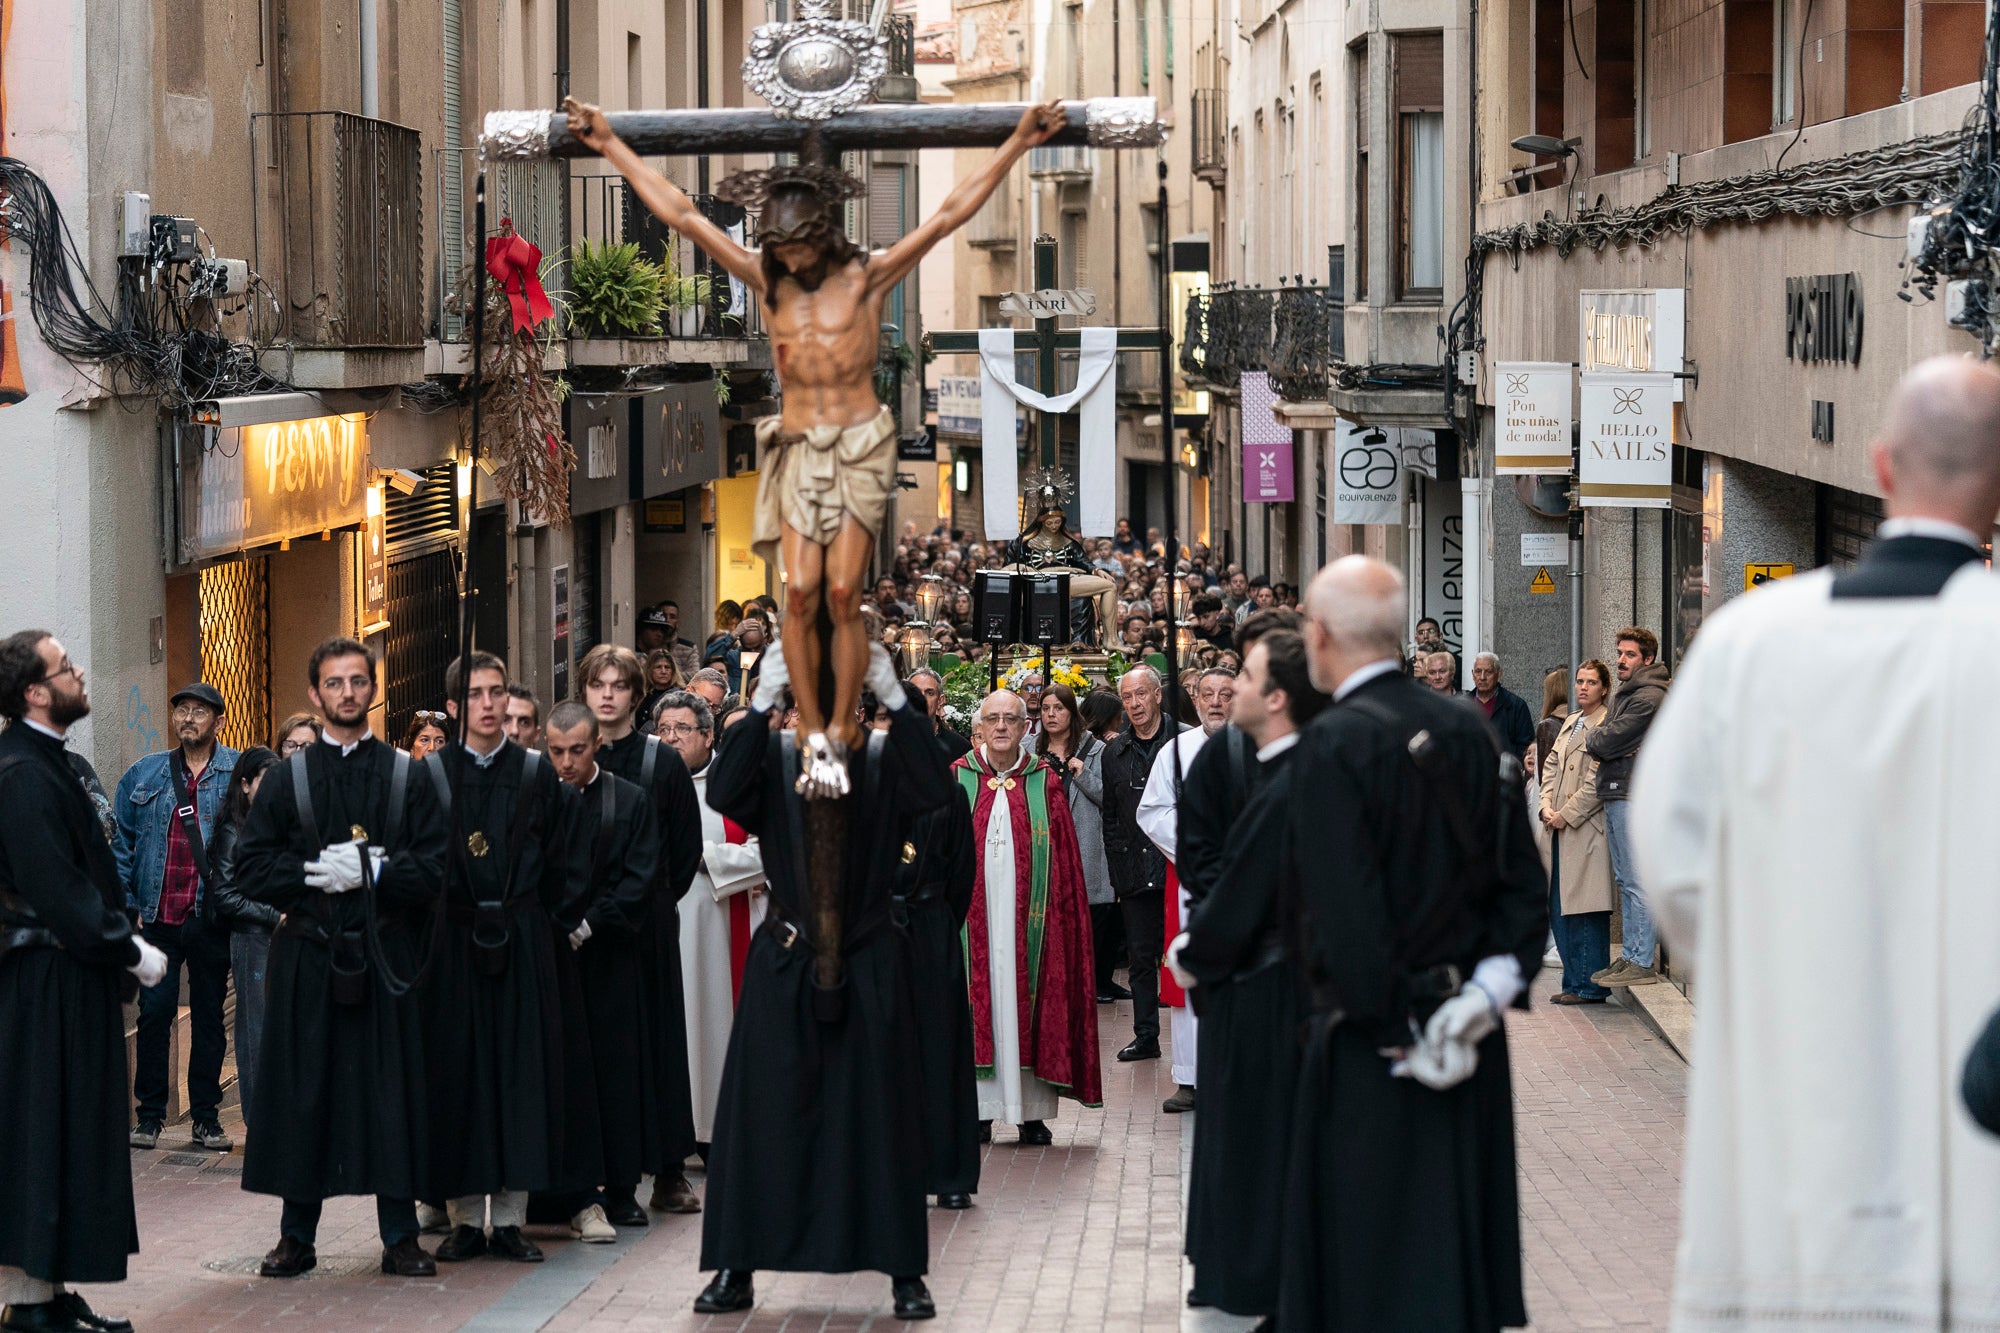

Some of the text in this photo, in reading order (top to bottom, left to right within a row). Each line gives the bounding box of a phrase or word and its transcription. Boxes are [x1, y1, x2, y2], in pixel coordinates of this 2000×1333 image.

[1786, 271, 1864, 364] POSITIVO
[1507, 399, 1536, 416] ¡Pon
[1506, 416, 1560, 427] tus uñas
[1506, 430, 1562, 442] de moda!
[1601, 424, 1658, 437] HELLO
[1588, 441, 1666, 461] NAILS
[264, 417, 355, 507] PENNY
